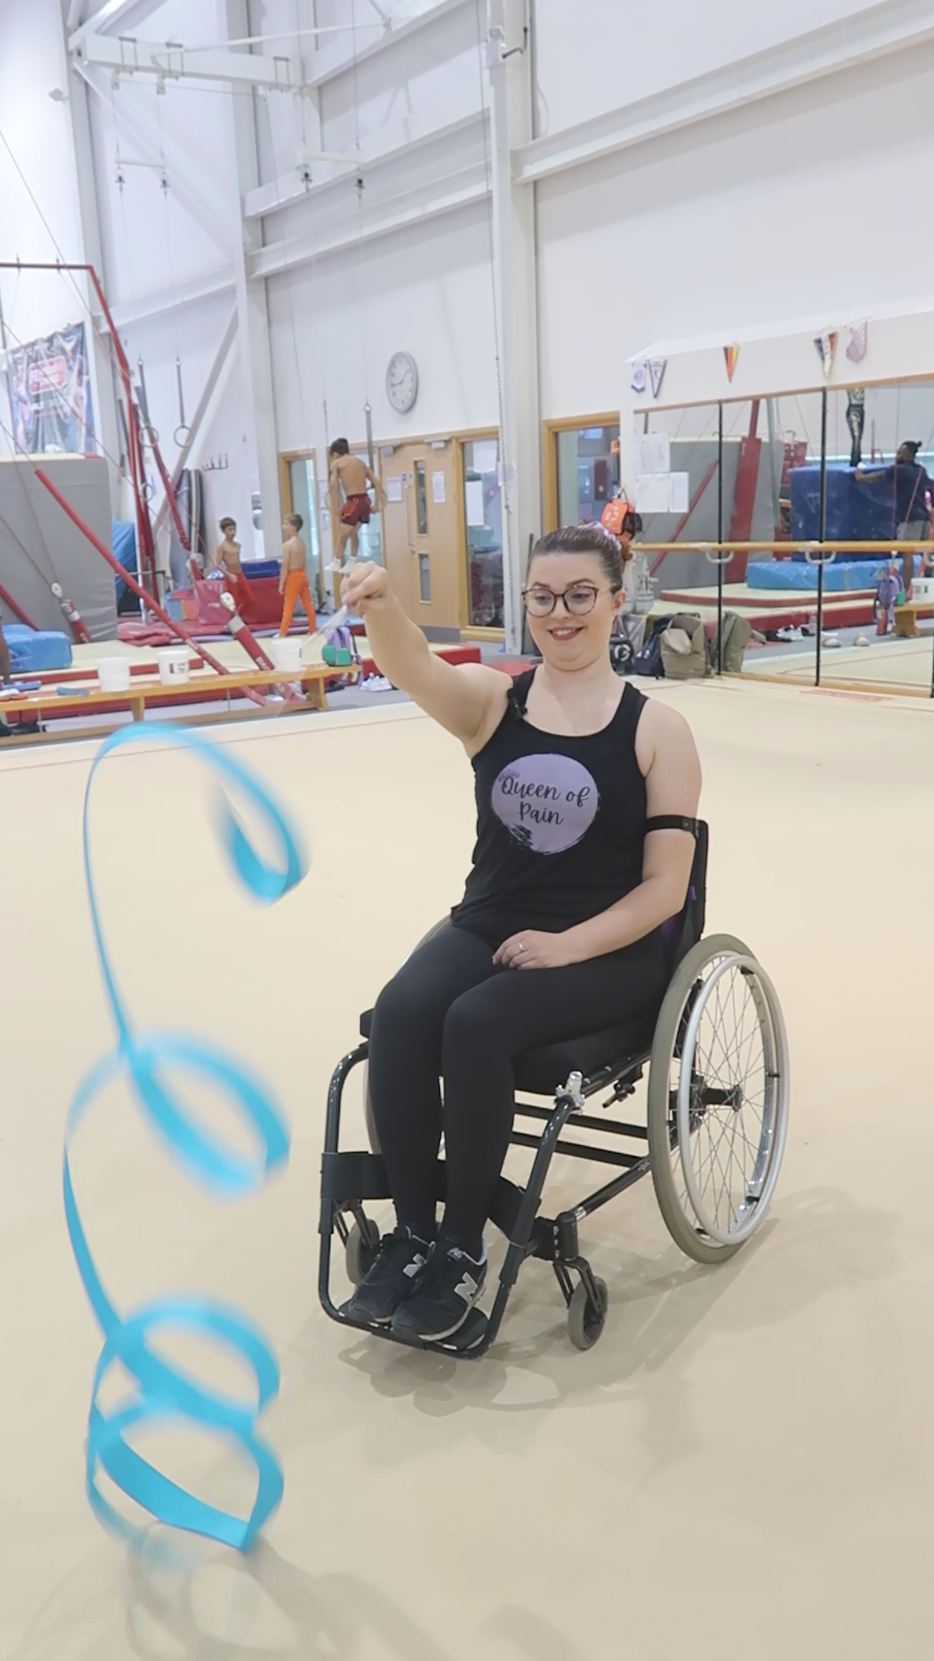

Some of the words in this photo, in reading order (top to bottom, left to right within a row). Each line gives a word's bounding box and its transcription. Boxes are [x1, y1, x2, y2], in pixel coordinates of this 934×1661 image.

[501, 776, 561, 801] Queen
[565, 786, 591, 808] of
[519, 801, 564, 825] Pain
[454, 1271, 478, 1305] N
